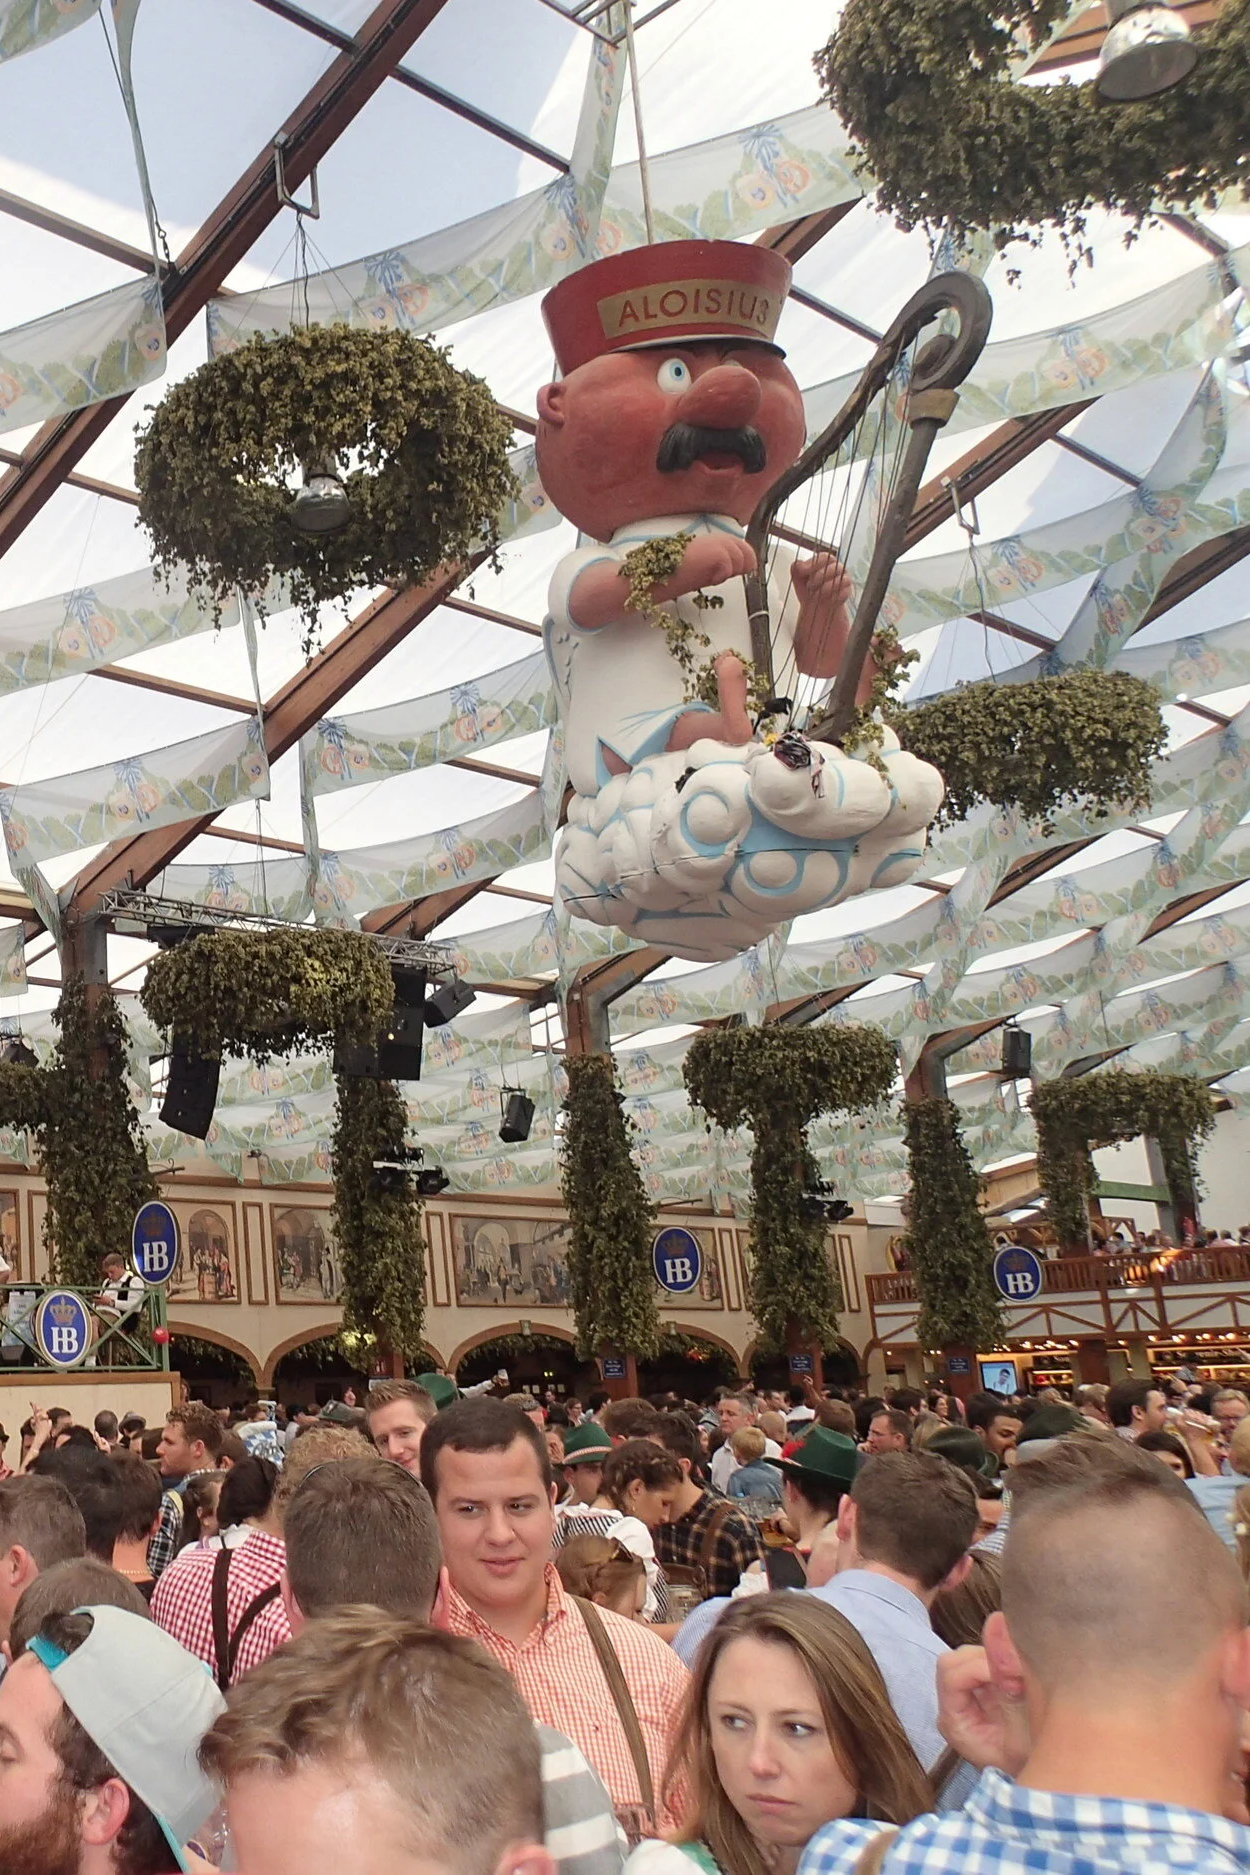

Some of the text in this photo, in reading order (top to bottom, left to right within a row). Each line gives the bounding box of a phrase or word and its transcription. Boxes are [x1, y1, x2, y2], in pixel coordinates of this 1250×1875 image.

[618, 288, 770, 328] ALOISIUS
[142, 1240, 169, 1273] HB
[664, 1257, 693, 1285] HB
[1005, 1272, 1035, 1295] HB
[50, 1326, 79, 1355] HB
